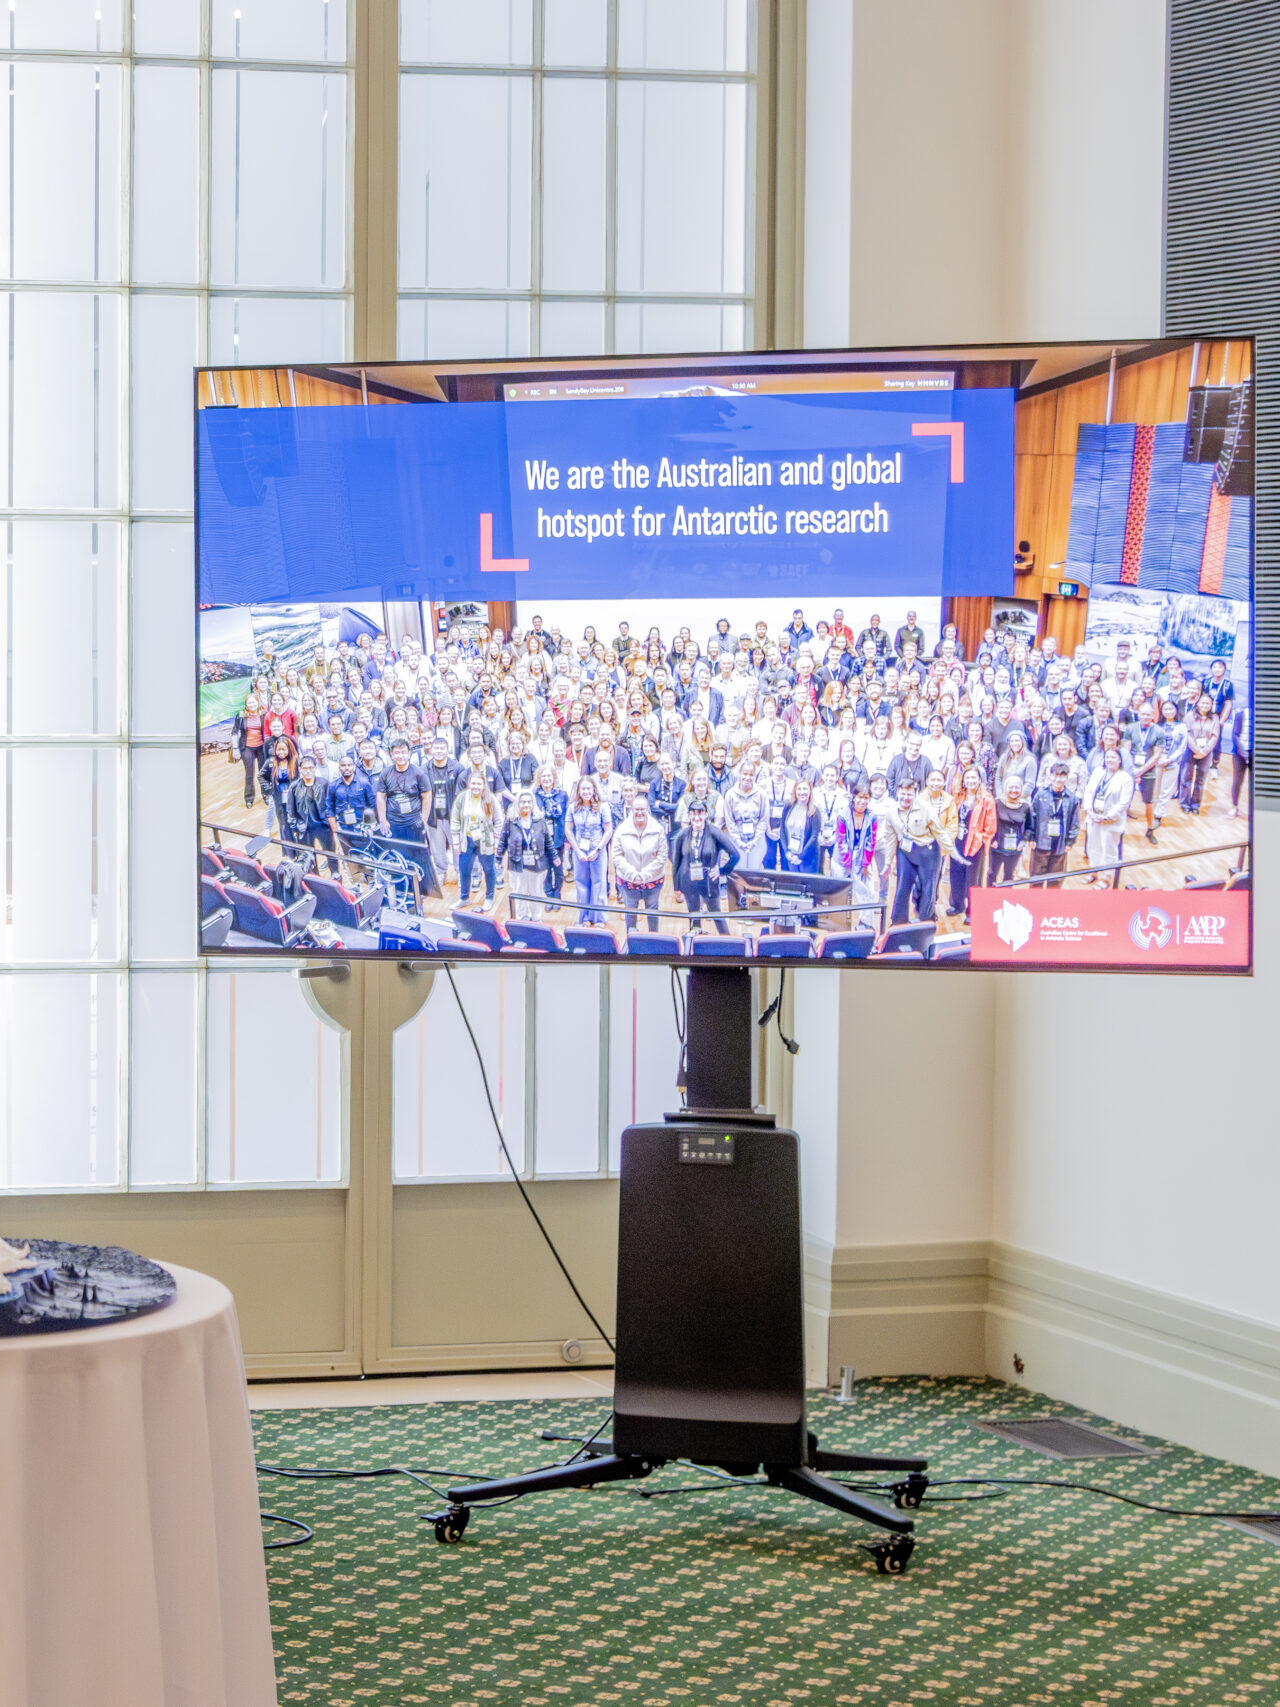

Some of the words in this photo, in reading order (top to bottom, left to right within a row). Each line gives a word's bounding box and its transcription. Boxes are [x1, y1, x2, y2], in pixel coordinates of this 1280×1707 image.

[525, 460, 559, 491] We
[567, 465, 604, 490] are
[612, 458, 650, 489] the
[657, 455, 772, 489] Australian
[780, 454, 823, 486] and
[832, 452, 902, 492] global
[537, 507, 625, 544] hotspot
[632, 505, 666, 537] for
[672, 504, 778, 537] Antarctic
[785, 502, 889, 534] research
[1040, 916, 1079, 929] ACEAS
